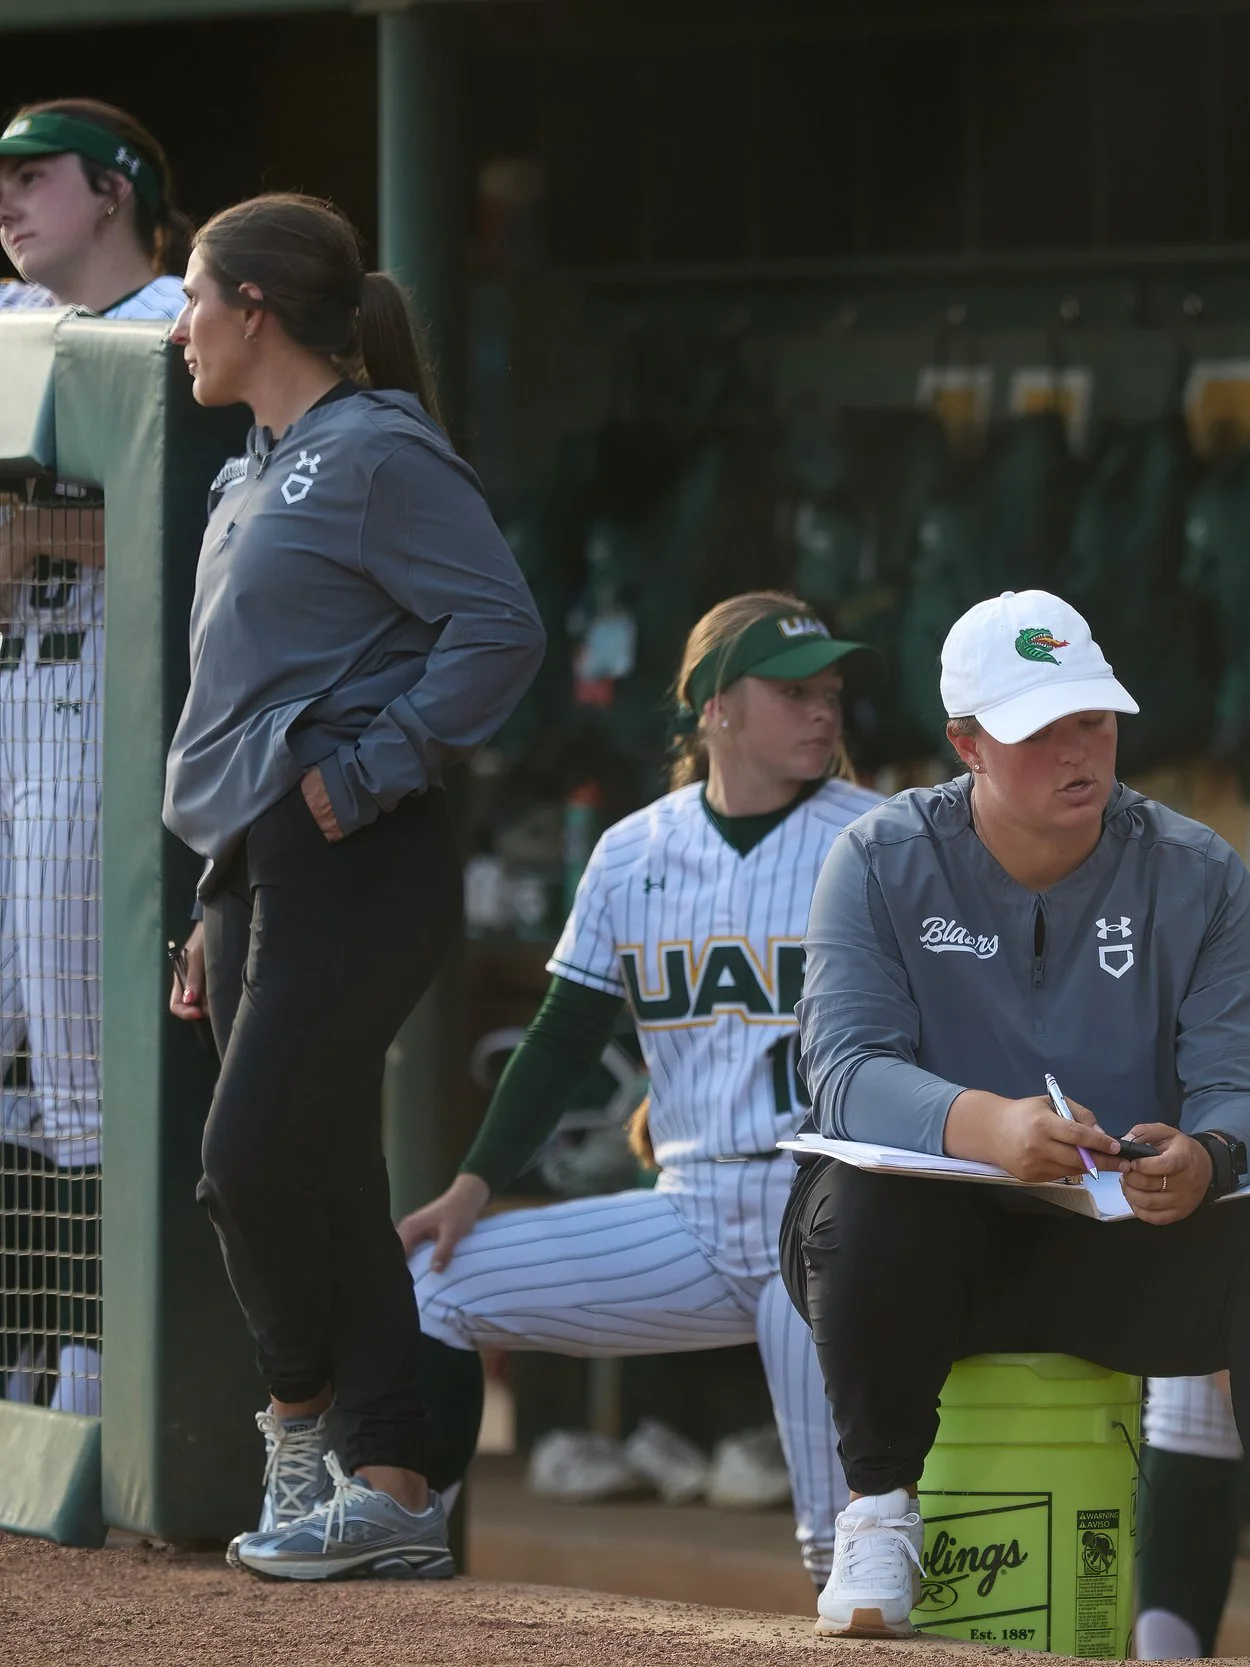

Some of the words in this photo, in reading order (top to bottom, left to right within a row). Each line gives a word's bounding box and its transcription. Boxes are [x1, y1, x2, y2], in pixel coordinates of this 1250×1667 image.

[1086, 1511, 1119, 1519] WARNING
[1086, 1520, 1110, 1529] AVISO
[920, 1530, 1029, 1597] lings
[970, 1629, 997, 1640] Est.
[1002, 1629, 1036, 1640] 1887
